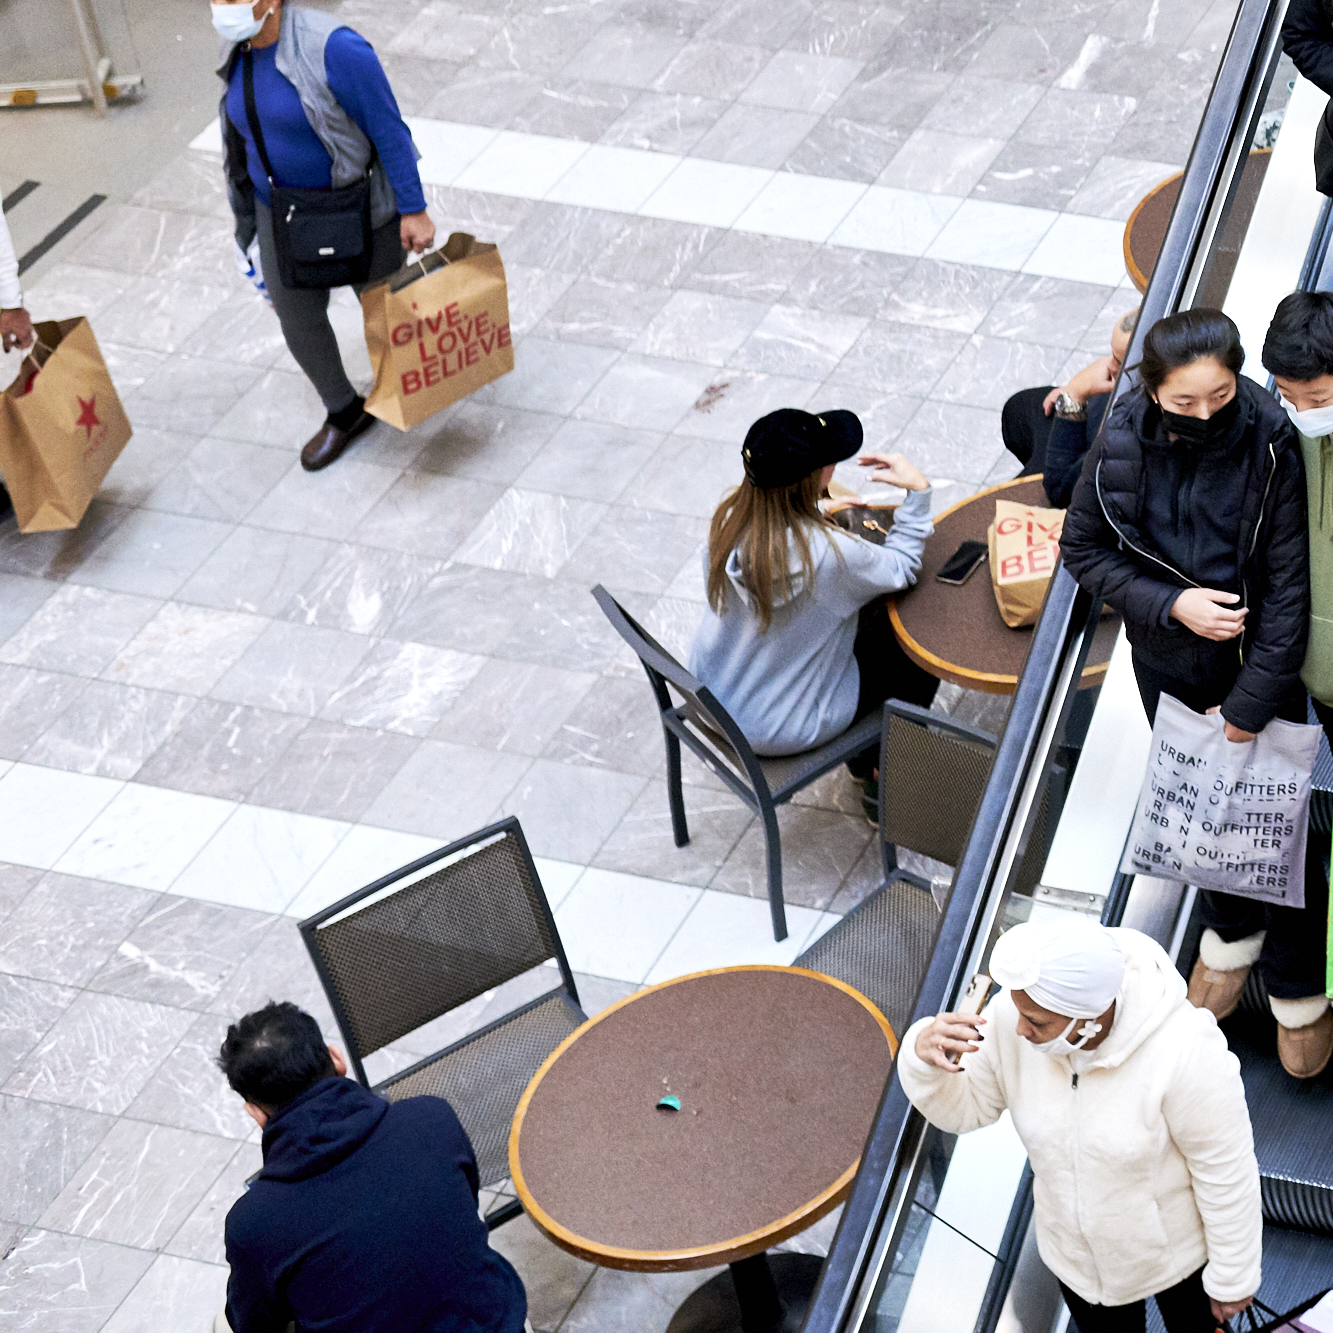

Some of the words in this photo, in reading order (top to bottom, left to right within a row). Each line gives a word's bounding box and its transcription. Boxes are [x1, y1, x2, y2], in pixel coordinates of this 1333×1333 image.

[400, 322, 512, 396] BELIEVE
[1151, 779, 1196, 812] URBAN
[1201, 820, 1294, 837] OUTFITTERS
